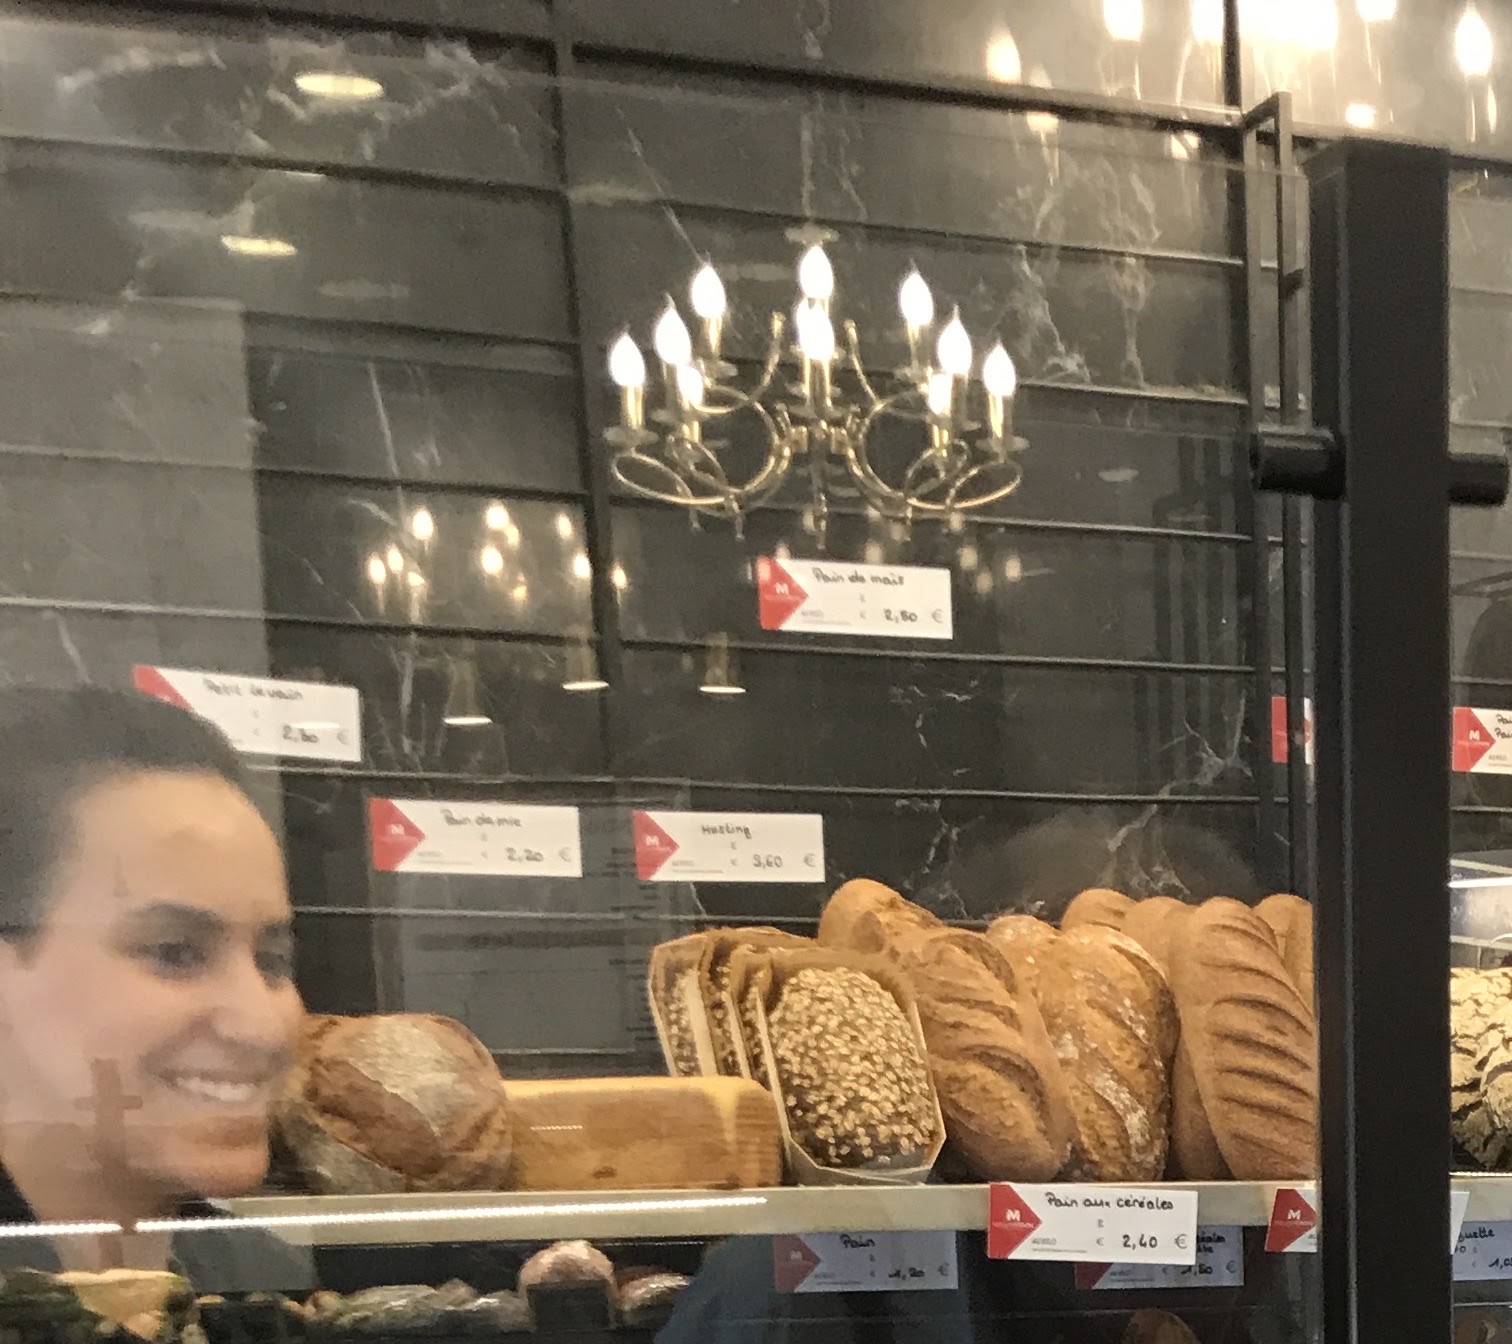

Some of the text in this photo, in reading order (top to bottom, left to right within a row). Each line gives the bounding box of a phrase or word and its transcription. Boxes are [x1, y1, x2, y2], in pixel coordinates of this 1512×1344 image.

[1044, 1191, 1079, 1209] Pain
[1005, 1208, 1021, 1222] M
[1287, 1209, 1301, 1220] M
[840, 1234, 876, 1249] Pain
[1122, 1234, 1159, 1250] 2,40
[1174, 1233, 1189, 1249] €
